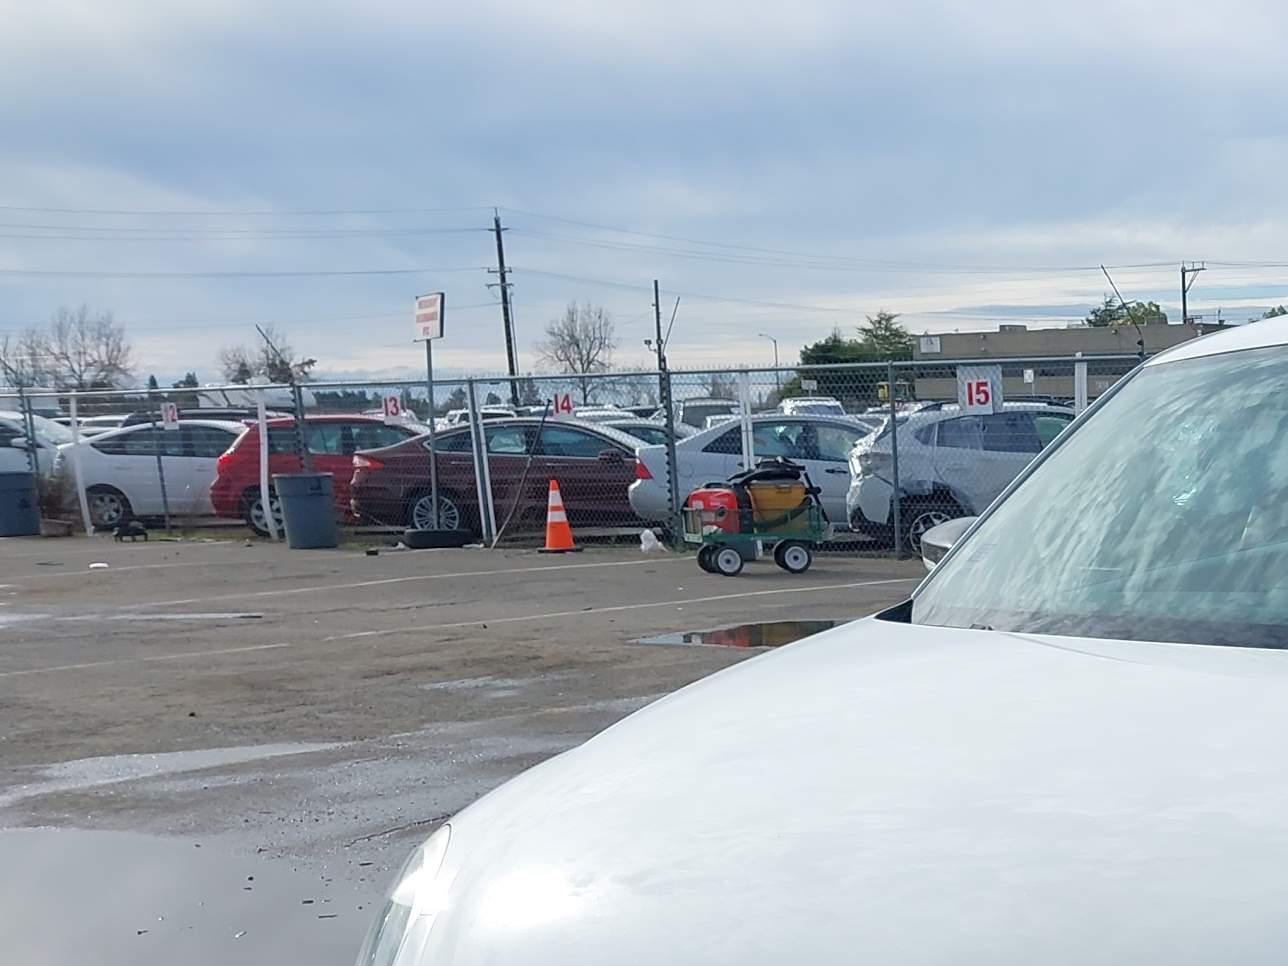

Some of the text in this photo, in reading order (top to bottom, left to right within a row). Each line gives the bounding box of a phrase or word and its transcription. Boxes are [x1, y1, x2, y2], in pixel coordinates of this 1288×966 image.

[967, 381, 990, 406] 15
[384, 397, 400, 416] 13
[554, 394, 573, 414] 14
